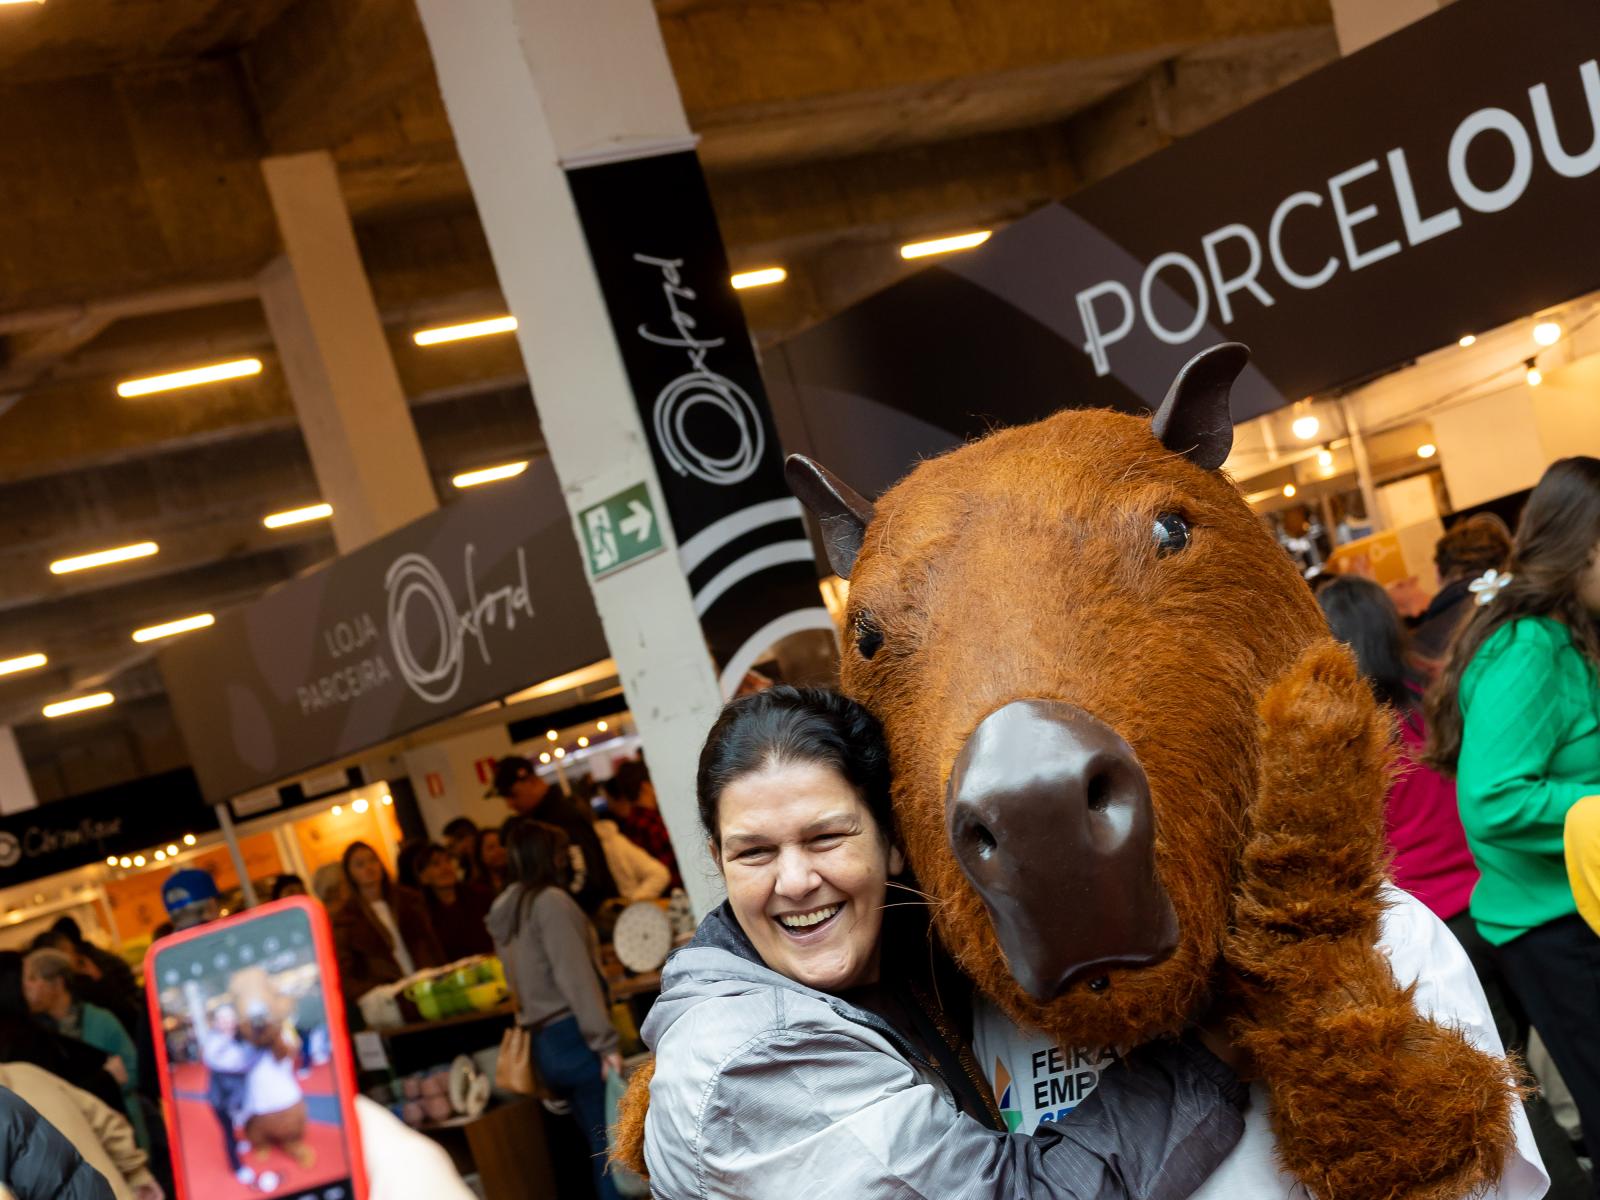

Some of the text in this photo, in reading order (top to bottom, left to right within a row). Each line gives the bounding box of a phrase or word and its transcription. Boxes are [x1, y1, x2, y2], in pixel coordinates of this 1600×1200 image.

[633, 252, 765, 486] Oxford
[324, 612, 379, 658] LOJA
[385, 543, 535, 703] Oxford
[296, 655, 392, 716] PARCEIRA
[1034, 1071, 1099, 1110] EMP
